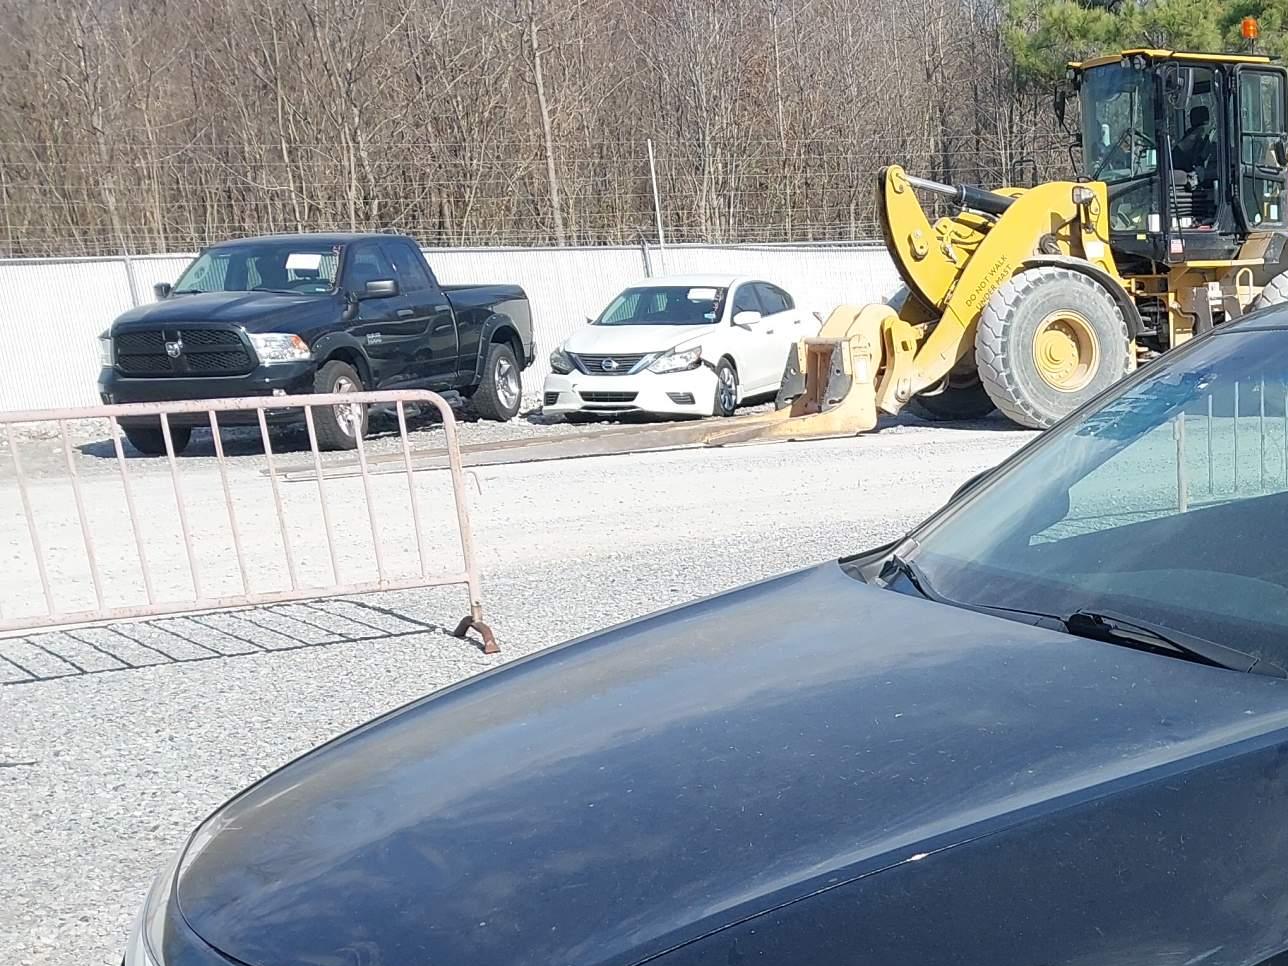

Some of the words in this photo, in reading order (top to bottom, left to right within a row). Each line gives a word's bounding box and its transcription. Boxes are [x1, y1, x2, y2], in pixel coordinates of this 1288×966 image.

[966, 294, 977, 307] DO
[976, 276, 990, 295] NOT
[989, 255, 1008, 277] WALK
[976, 284, 997, 310] UNDER
